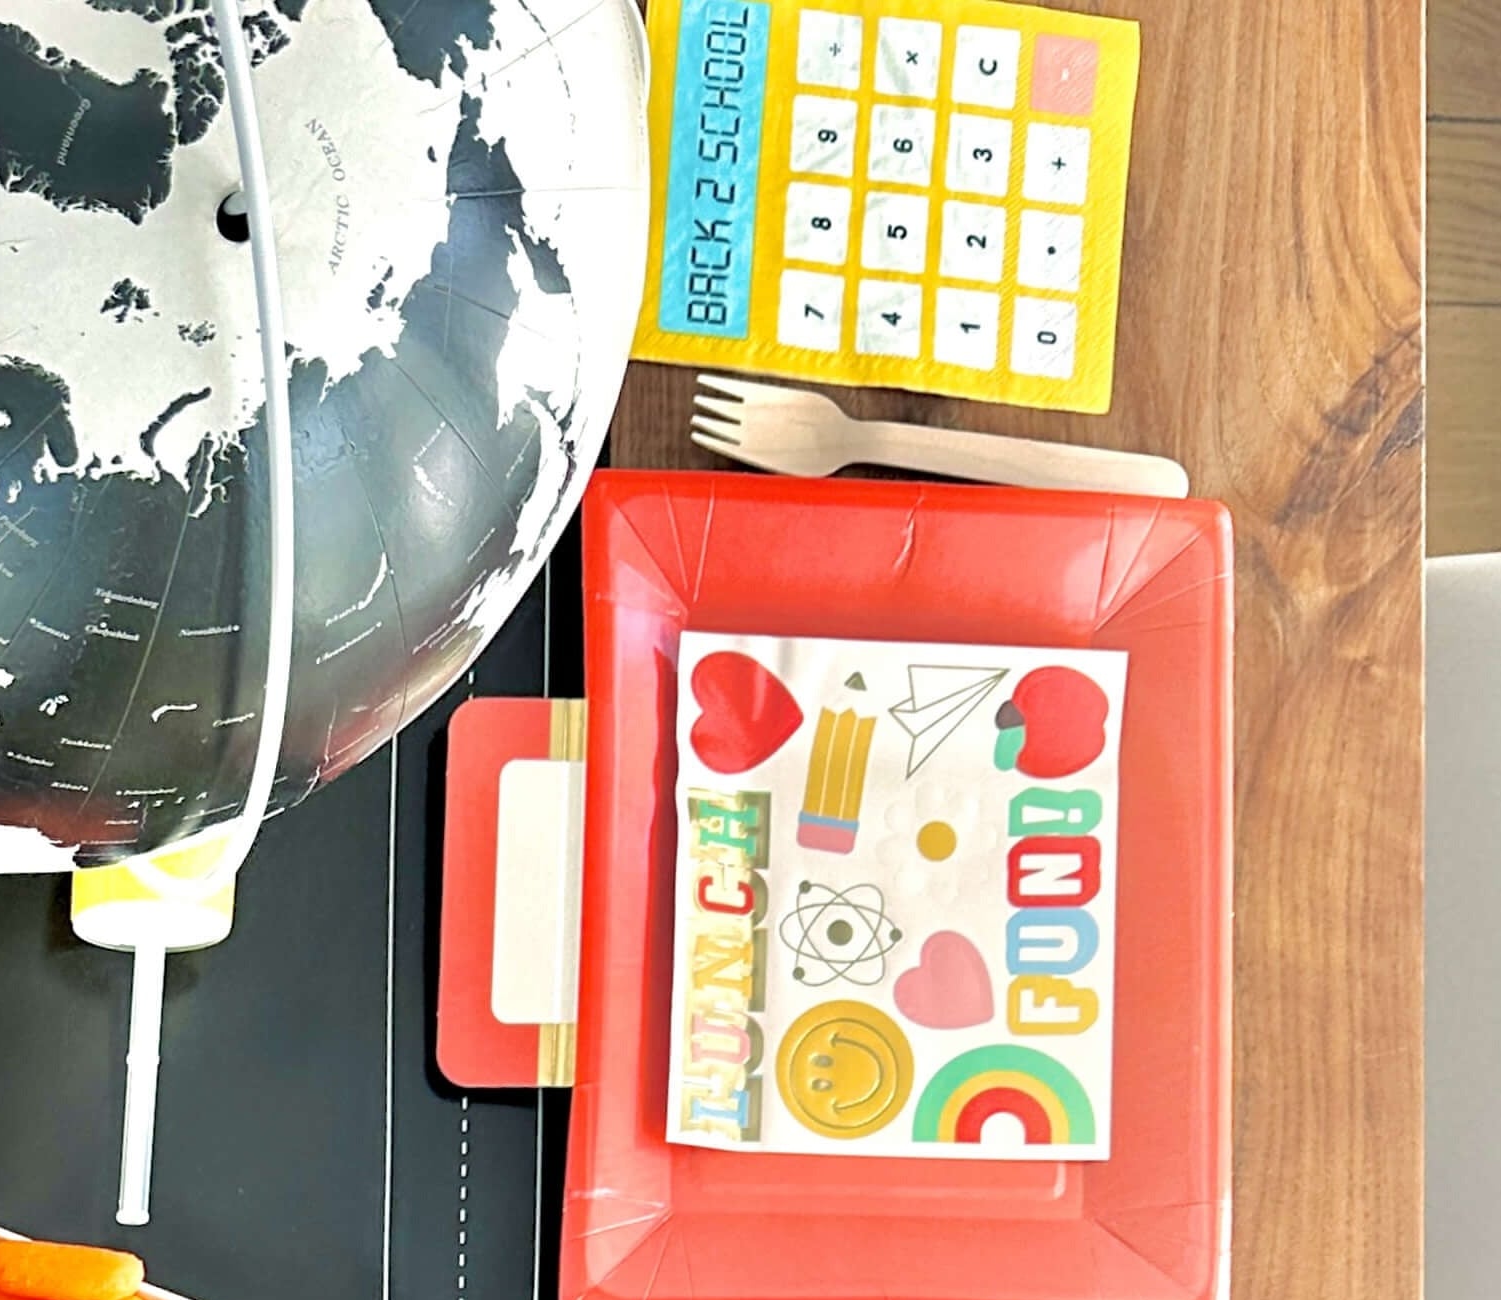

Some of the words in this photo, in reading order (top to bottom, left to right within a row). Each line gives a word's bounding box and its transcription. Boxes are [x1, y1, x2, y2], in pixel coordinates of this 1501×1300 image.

[978, 58, 998, 76] C
[697, 5, 750, 165] SCHOOL
[55, 97, 93, 167] Greenland
[817, 129, 838, 143] 9
[304, 117, 346, 182] OCEAN
[893, 138, 913, 153] 6
[972, 148, 993, 163] 3
[696, 175, 735, 205] 2
[811, 217, 832, 231] 8
[887, 224, 908, 240] 5
[326, 194, 352, 278] ARCTIC
[966, 234, 987, 249] 2
[686, 219, 732, 328] BACK
[804, 304, 824, 319] 7
[881, 312, 902, 327] 4
[960, 322, 981, 333] 1
[1036, 330, 1057, 345] 0
[1005, 785, 1103, 1036] FUN!
[680, 788, 770, 1141] LUNCH
